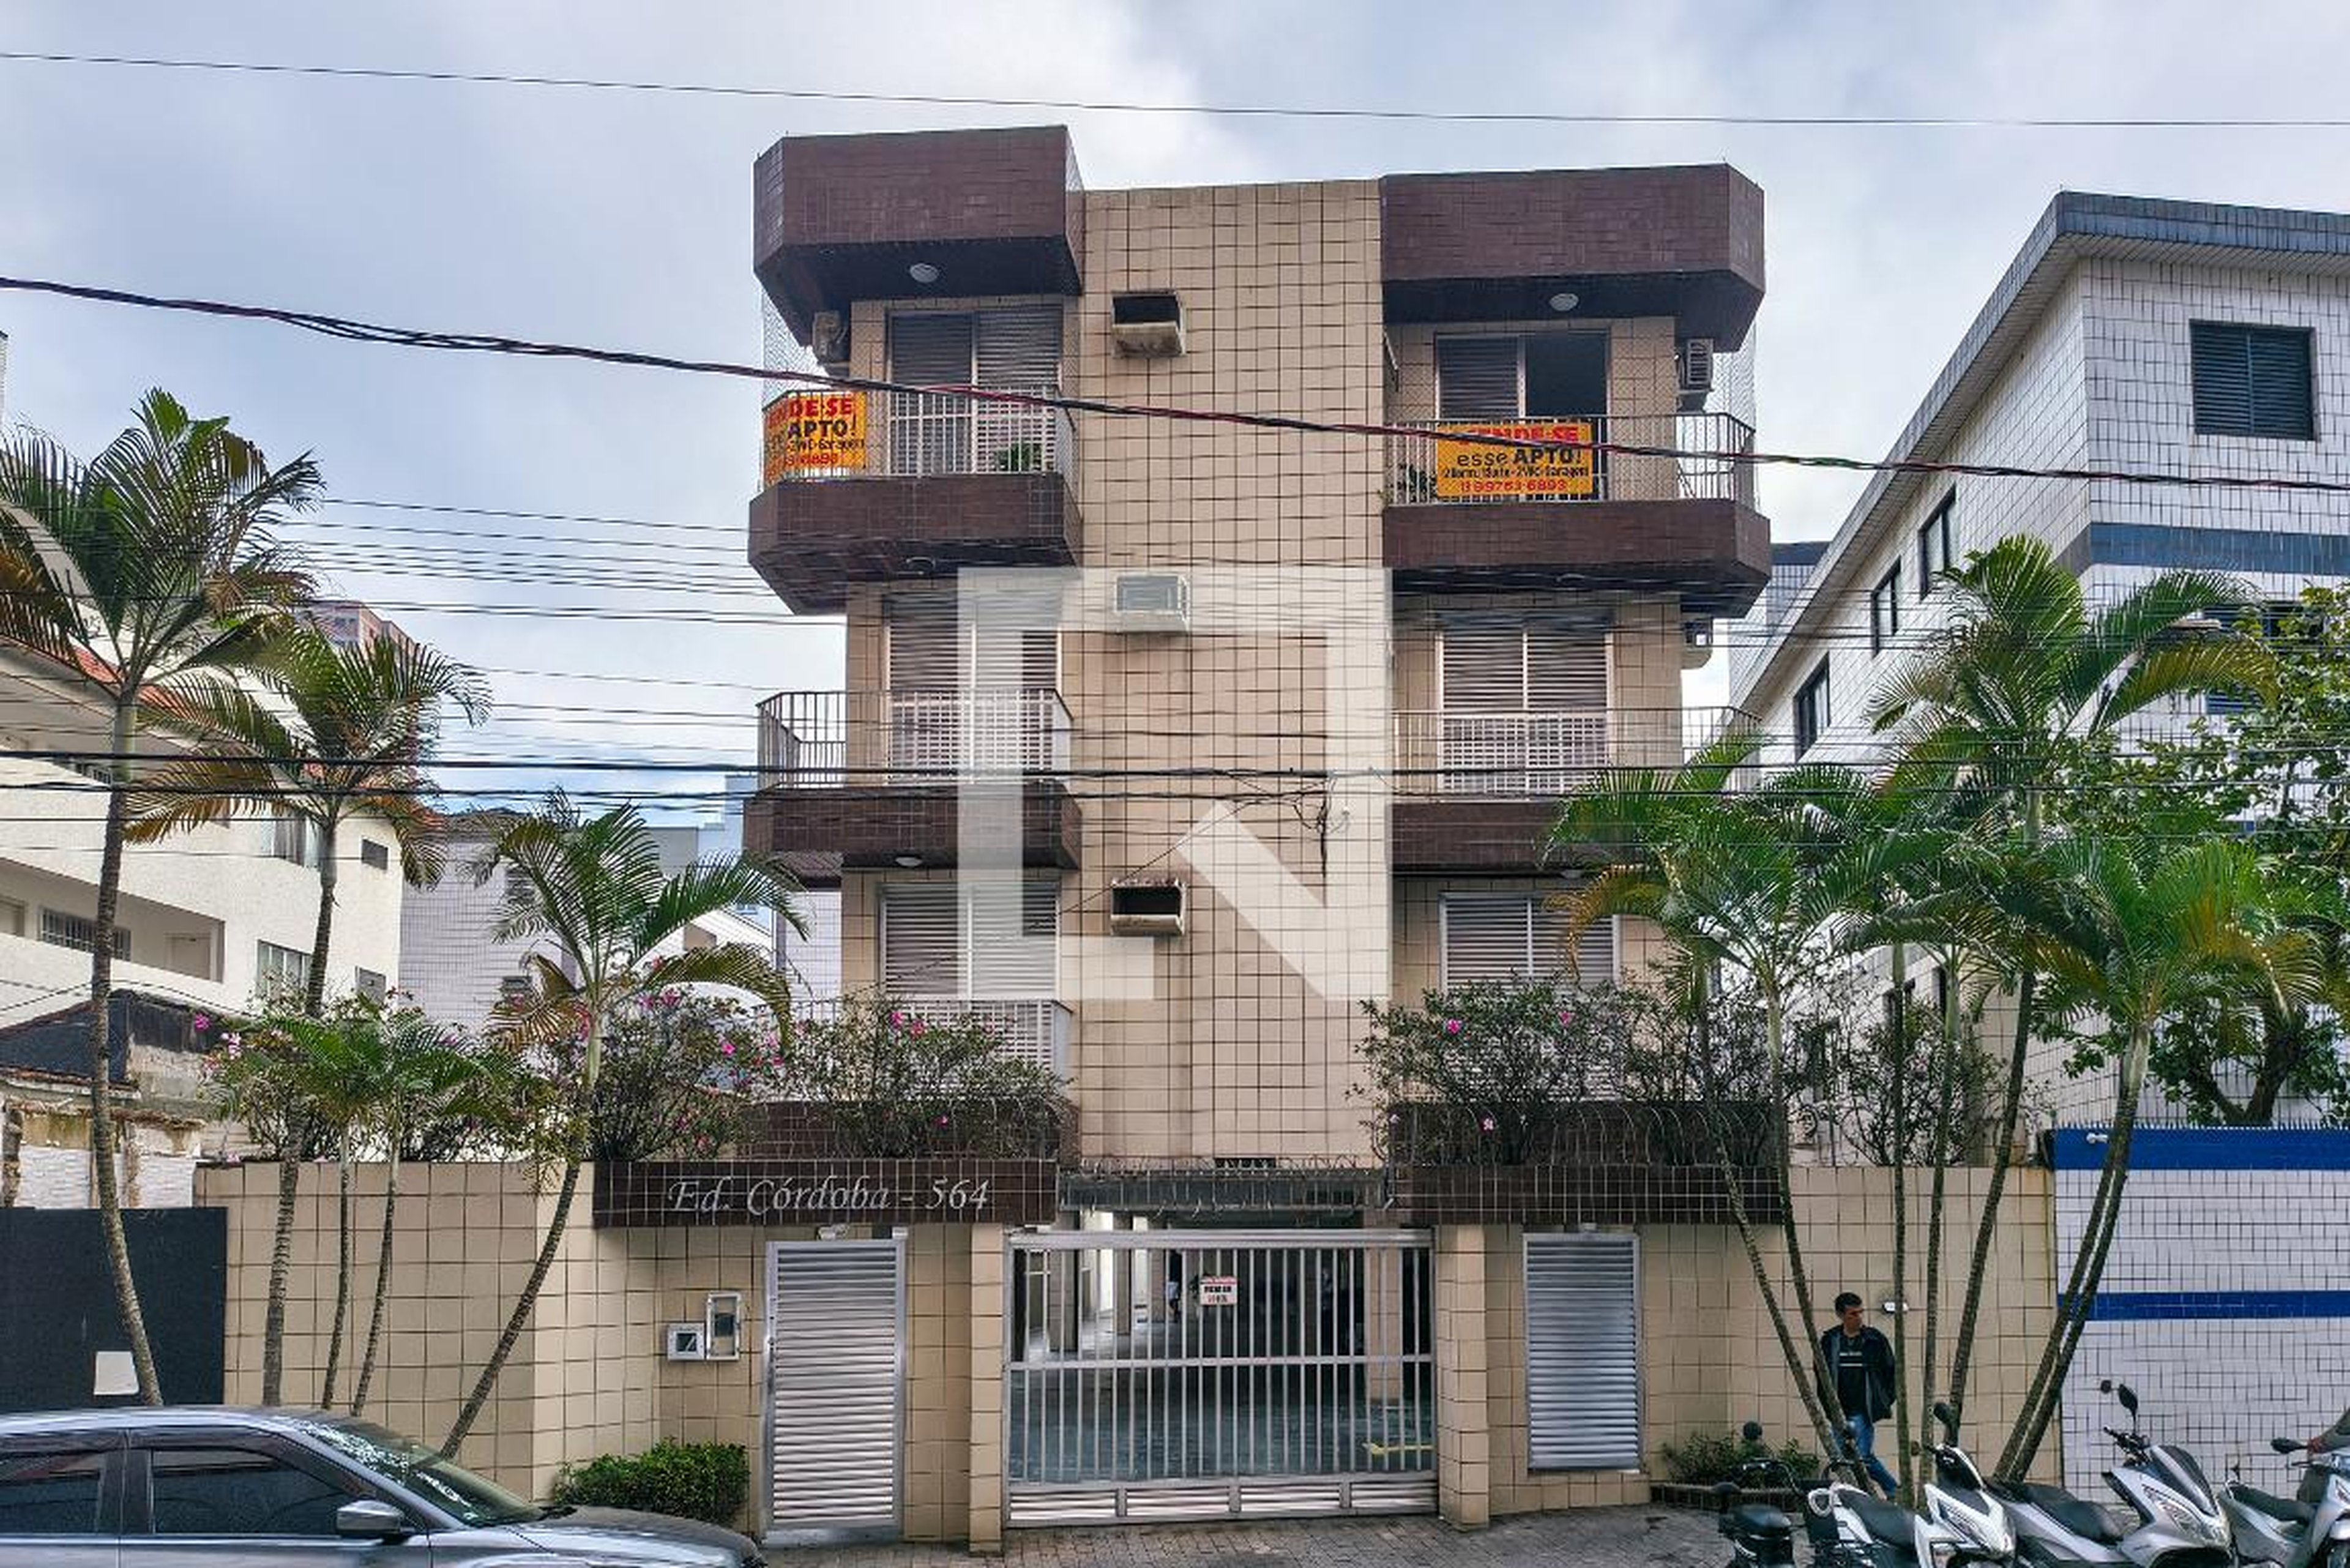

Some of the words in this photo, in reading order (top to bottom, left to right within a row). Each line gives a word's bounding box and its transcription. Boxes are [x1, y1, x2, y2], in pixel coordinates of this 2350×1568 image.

[1458, 452, 1508, 467] esse
[1512, 447, 1582, 465] APTO!
[668, 1175, 733, 1211] Ed.
[746, 1174, 890, 1215] Córdoba
[925, 1176, 991, 1210] 564
